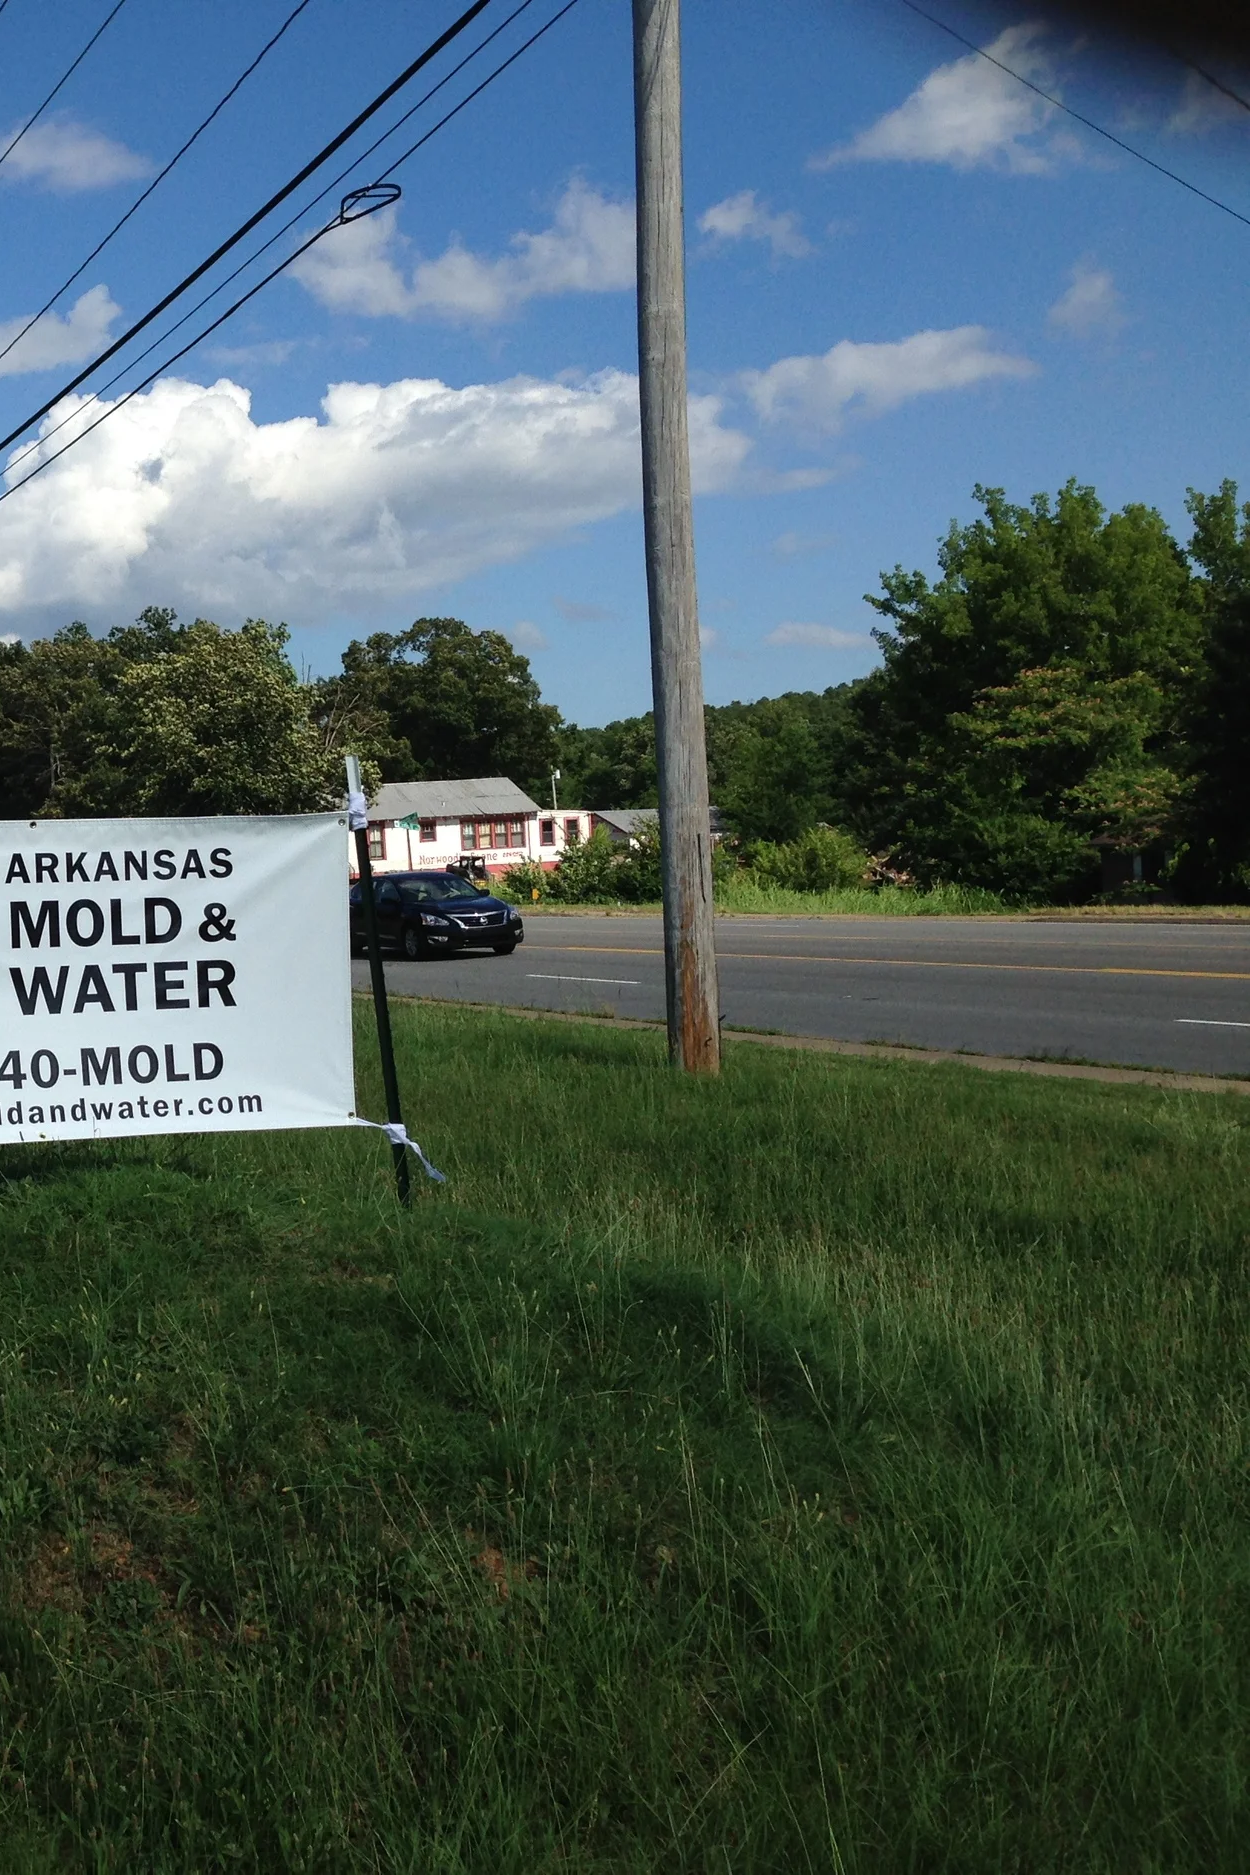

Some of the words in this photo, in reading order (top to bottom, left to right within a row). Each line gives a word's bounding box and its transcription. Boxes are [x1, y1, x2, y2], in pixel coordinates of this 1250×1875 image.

[5, 847, 233, 884] ARKANSAS
[9, 897, 182, 949] MOLD
[198, 902, 237, 943] &
[8, 959, 238, 1016] WATER
